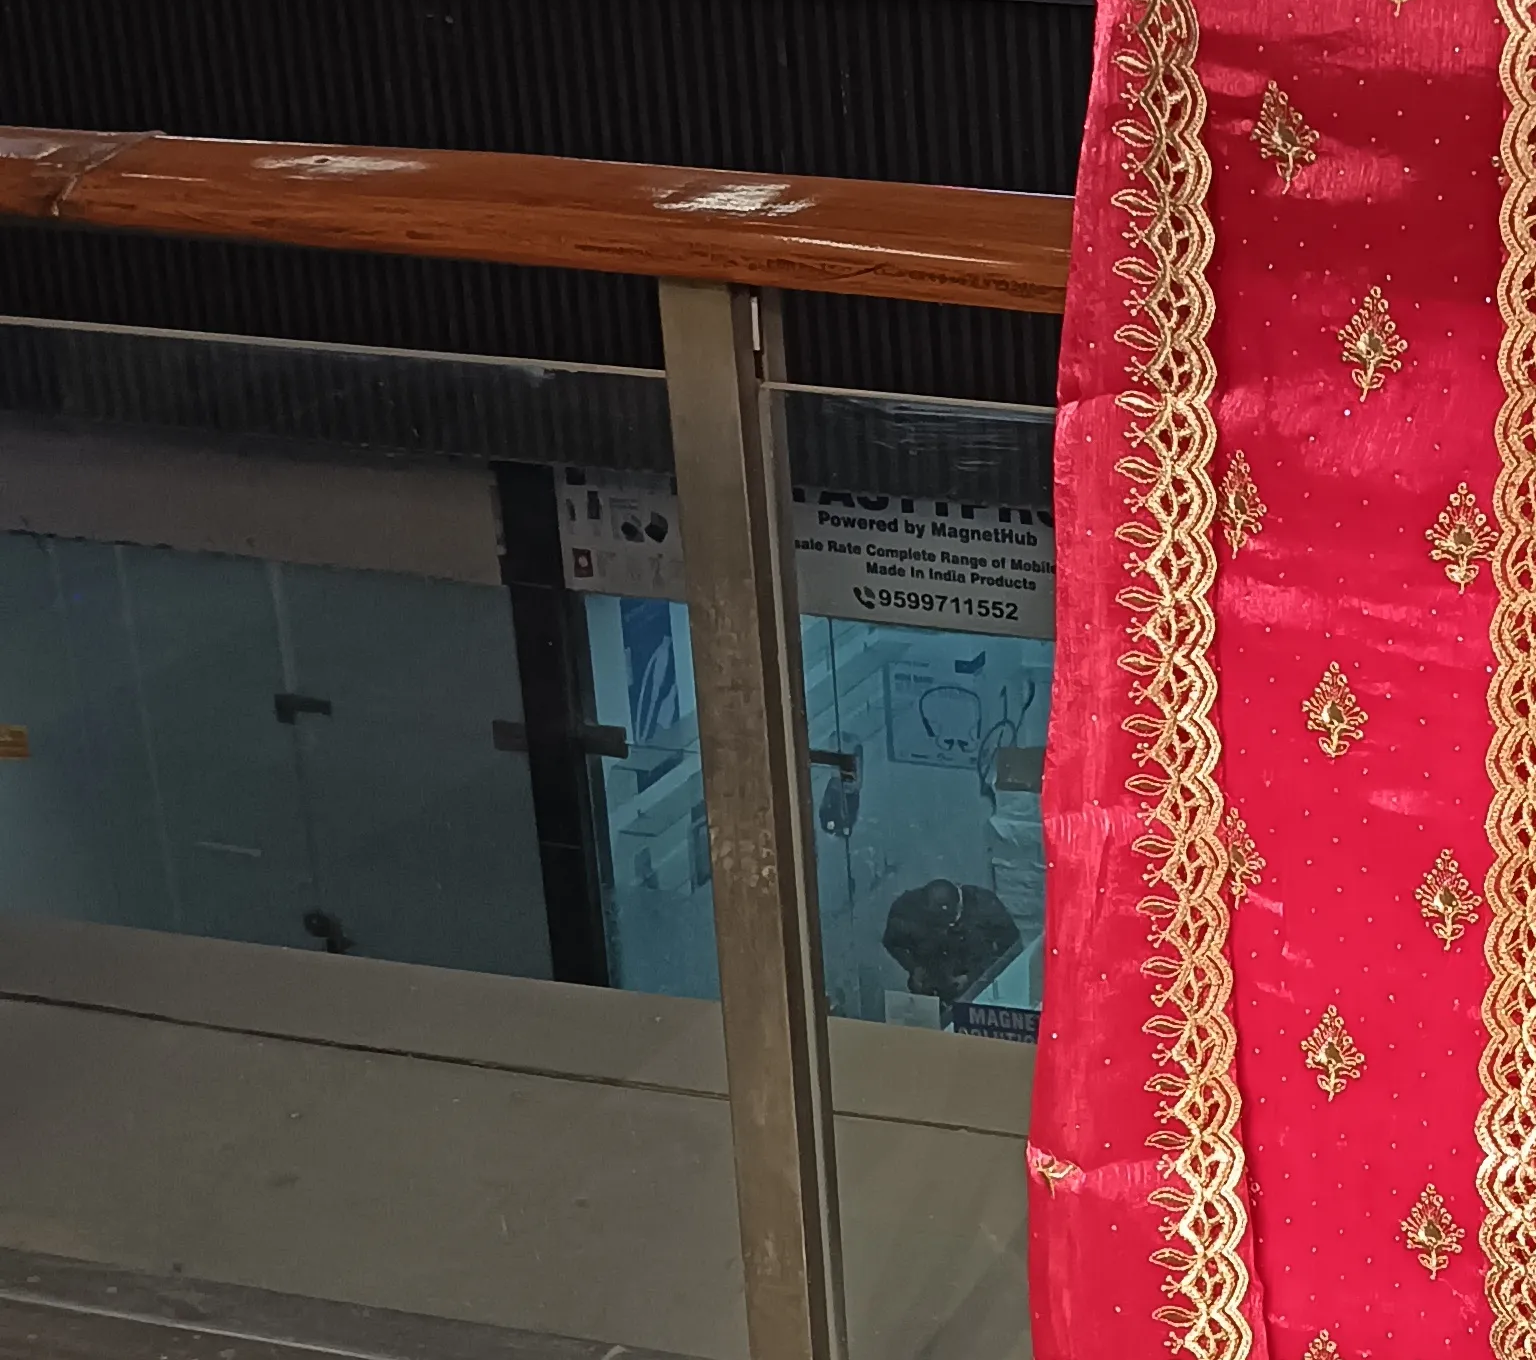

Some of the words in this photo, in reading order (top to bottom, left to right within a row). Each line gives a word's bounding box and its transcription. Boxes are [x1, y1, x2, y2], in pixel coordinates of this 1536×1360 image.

[817, 509, 899, 533] Powered
[904, 518, 925, 539] by
[931, 521, 1038, 547] MagnetHub
[827, 540, 862, 556] Rate
[866, 543, 936, 563] Complete
[941, 550, 988, 570] Range
[992, 556, 1006, 570] of
[866, 561, 906, 578] Made
[911, 565, 925, 579] In
[929, 568, 966, 584] India
[970, 571, 1037, 591] Products
[877, 588, 1020, 621] 9599711552
